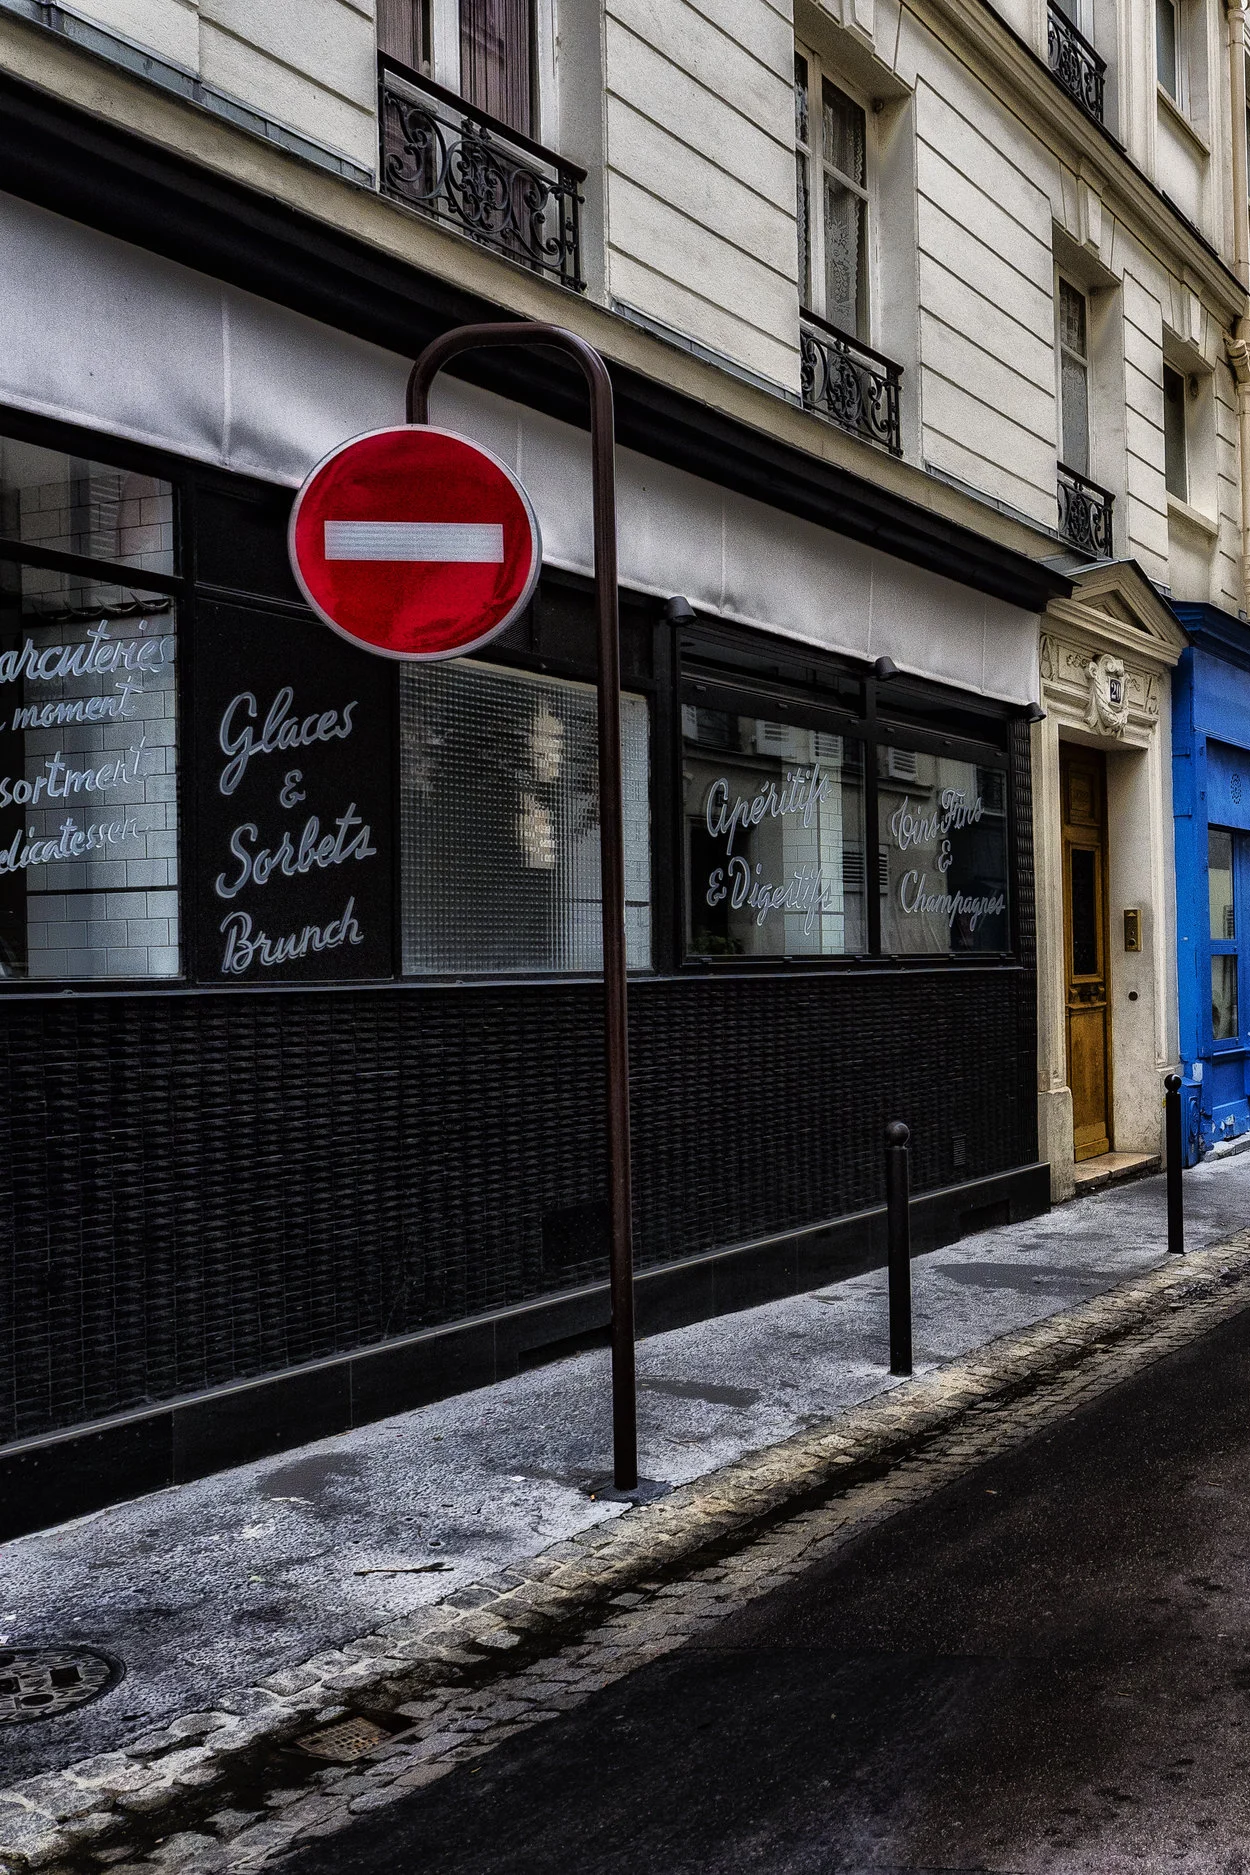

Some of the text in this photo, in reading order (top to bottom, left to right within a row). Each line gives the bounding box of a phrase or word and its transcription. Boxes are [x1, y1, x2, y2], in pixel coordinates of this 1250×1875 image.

[12, 676, 143, 731] moment
[1110, 681, 1121, 700] 20
[219, 686, 359, 796] Glaces
[279, 769, 306, 808] &
[706, 763, 833, 856] Apéritifs
[215, 802, 377, 898] Sorbets
[938, 840, 953, 873] &
[707, 856, 833, 936] & Digestifs
[901, 869, 1006, 931] Champagnes
[220, 896, 364, 974] Brunch
